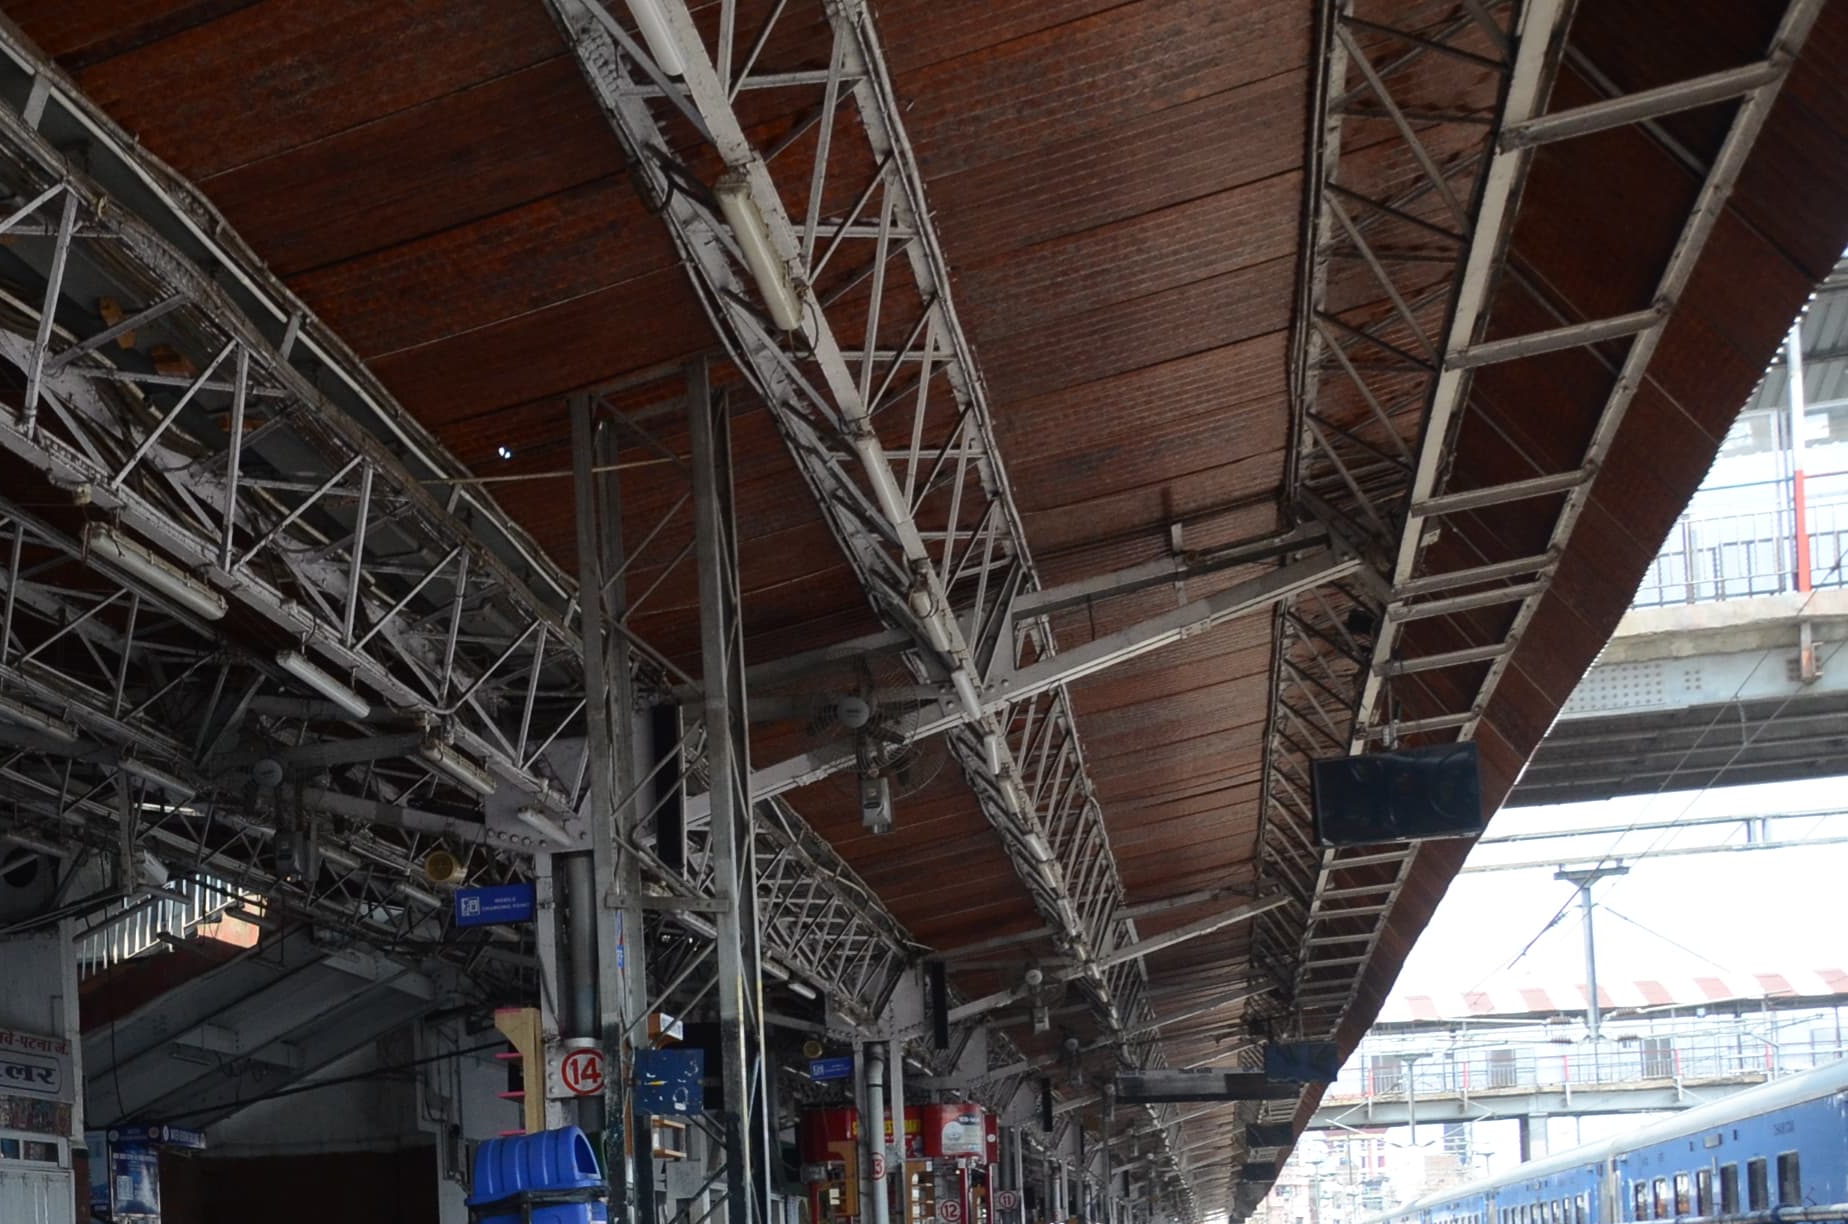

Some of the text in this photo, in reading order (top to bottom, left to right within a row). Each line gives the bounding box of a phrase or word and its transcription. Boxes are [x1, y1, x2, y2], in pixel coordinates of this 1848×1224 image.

[570, 1057, 601, 1085] 14
[1002, 1195, 1012, 1206] 11
[943, 1204, 958, 1218] 12
